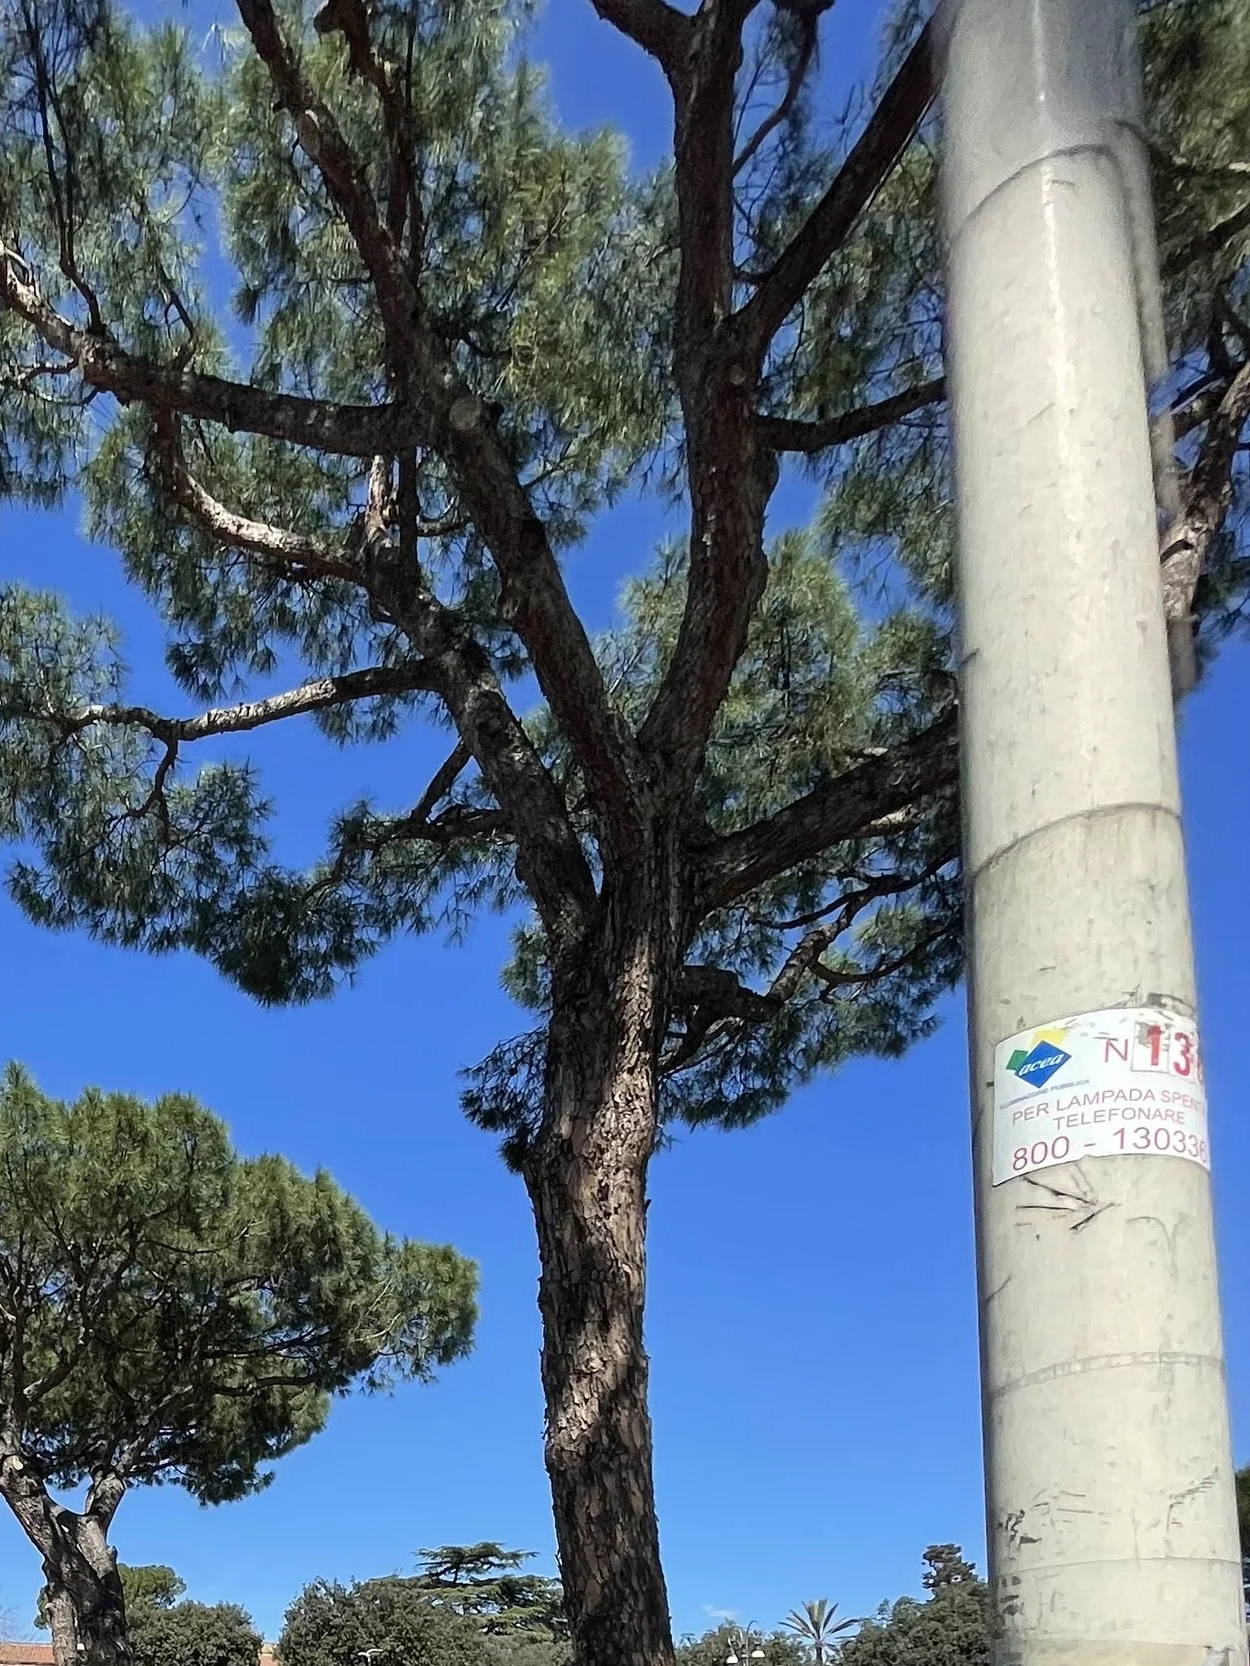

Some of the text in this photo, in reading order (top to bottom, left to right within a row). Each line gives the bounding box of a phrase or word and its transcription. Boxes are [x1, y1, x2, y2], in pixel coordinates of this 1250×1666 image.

[1104, 1038, 1129, 1063] N
[1018, 1053, 1065, 1077] acea
[1012, 1102, 1050, 1126] PER
[1056, 1088, 1156, 1112] LAMPADA
[1053, 1106, 1185, 1131] TELEFONARE
[1012, 1135, 1071, 1171] 800
